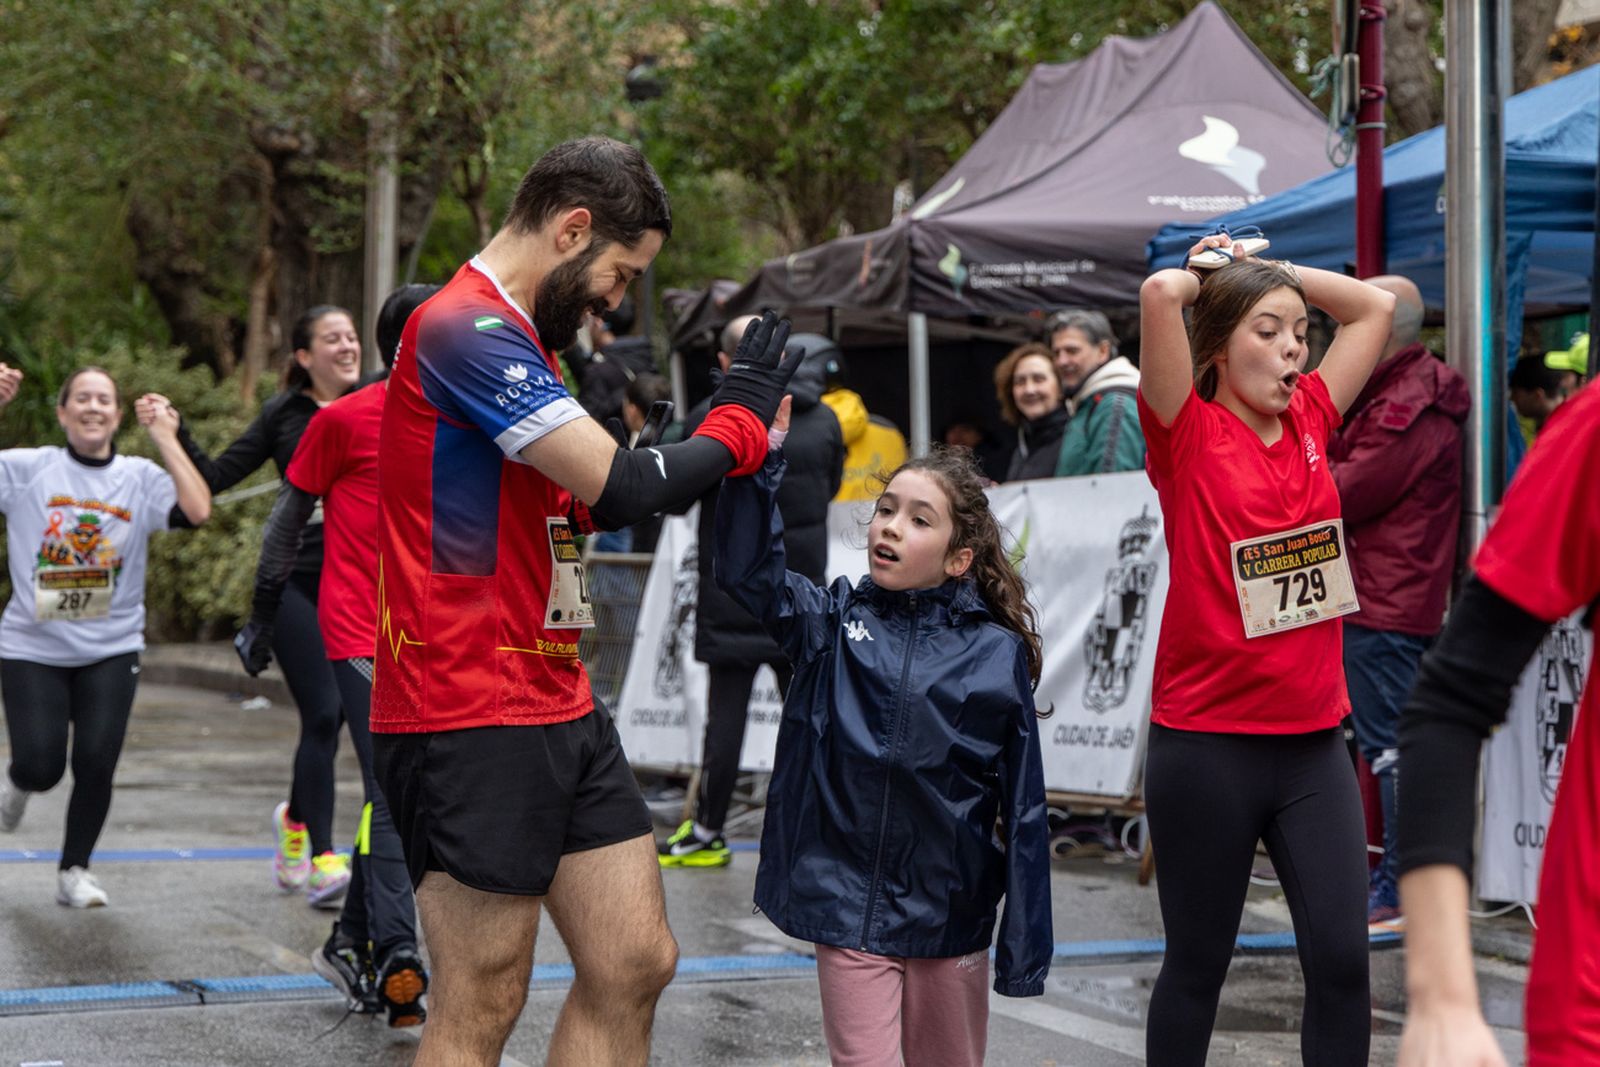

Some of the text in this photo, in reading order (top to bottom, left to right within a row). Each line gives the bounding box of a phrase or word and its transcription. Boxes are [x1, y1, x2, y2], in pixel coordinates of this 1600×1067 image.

[1263, 543, 1284, 556] San
[1286, 537, 1308, 551] Juan
[1308, 531, 1331, 545] Bosco
[1242, 543, 1337, 577] V CARRERA POPULAR
[56, 592, 92, 610] 287
[1272, 567, 1327, 612] 729
[1514, 821, 1545, 849] CIUD
